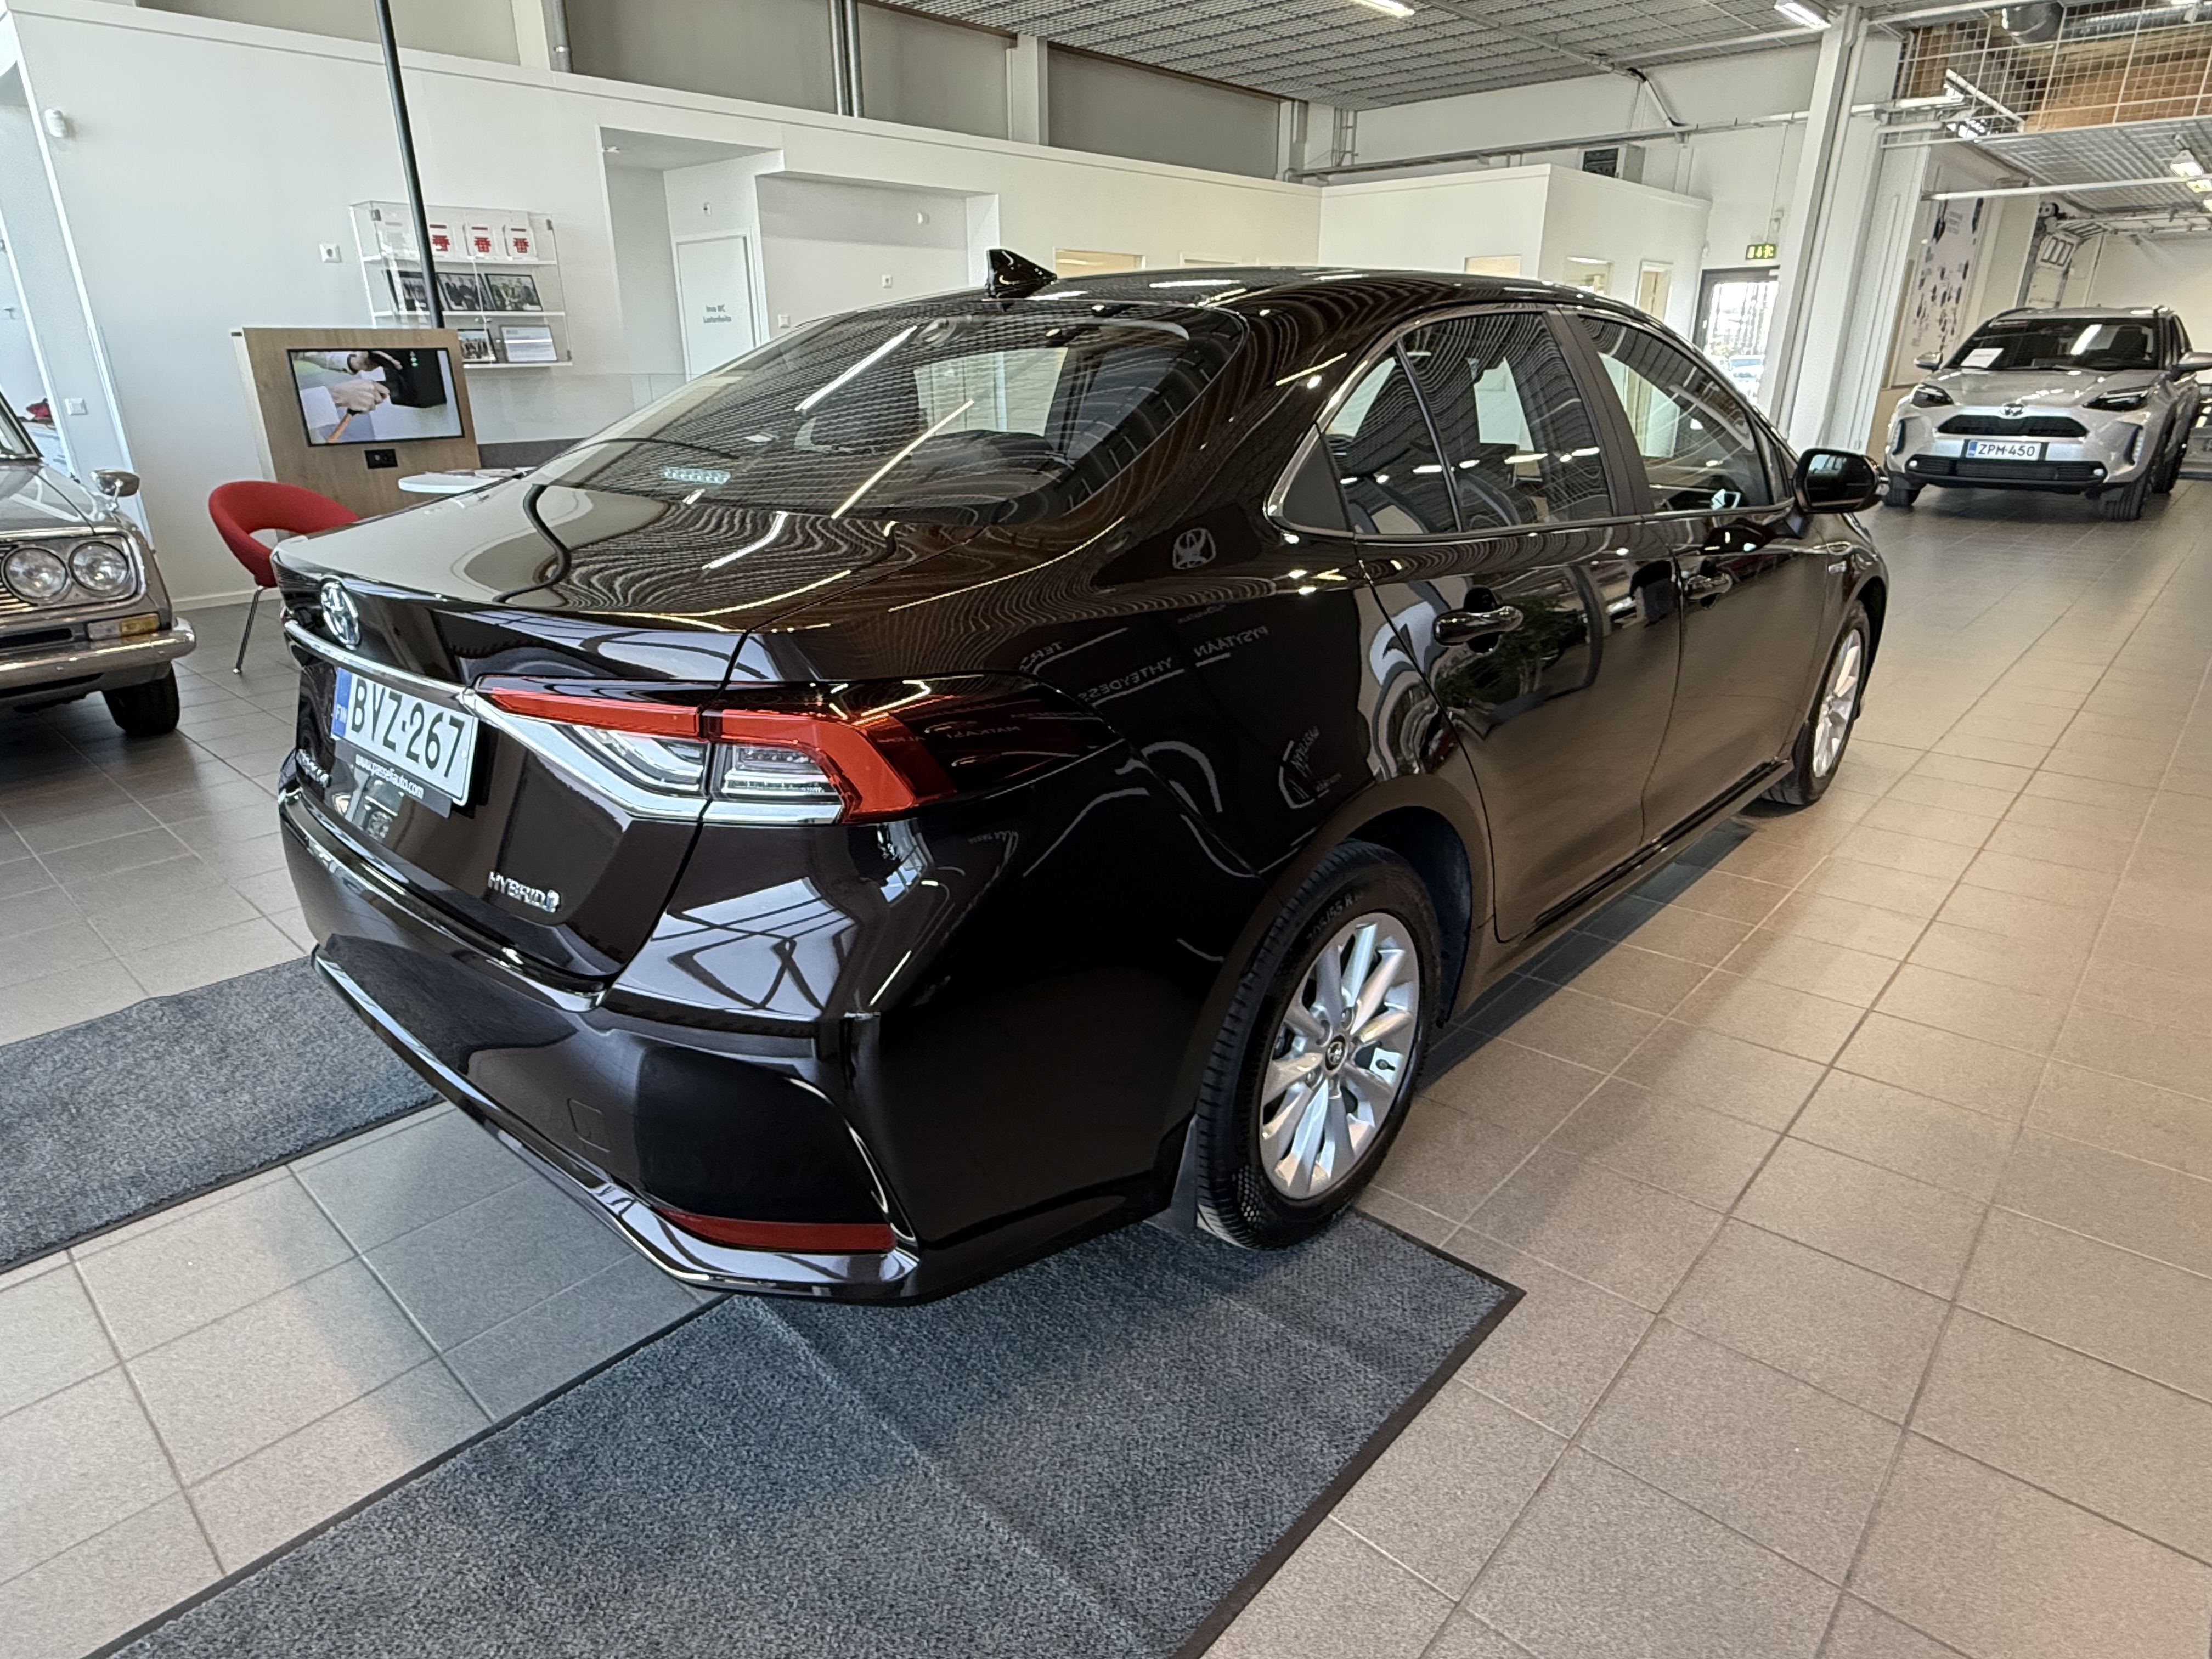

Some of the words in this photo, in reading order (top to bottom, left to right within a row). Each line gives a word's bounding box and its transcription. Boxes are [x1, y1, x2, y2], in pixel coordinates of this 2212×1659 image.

[1978, 443, 2035, 456] ZPM-450
[351, 678, 465, 778] BVZ-267
[487, 871, 547, 908] HYBRID
